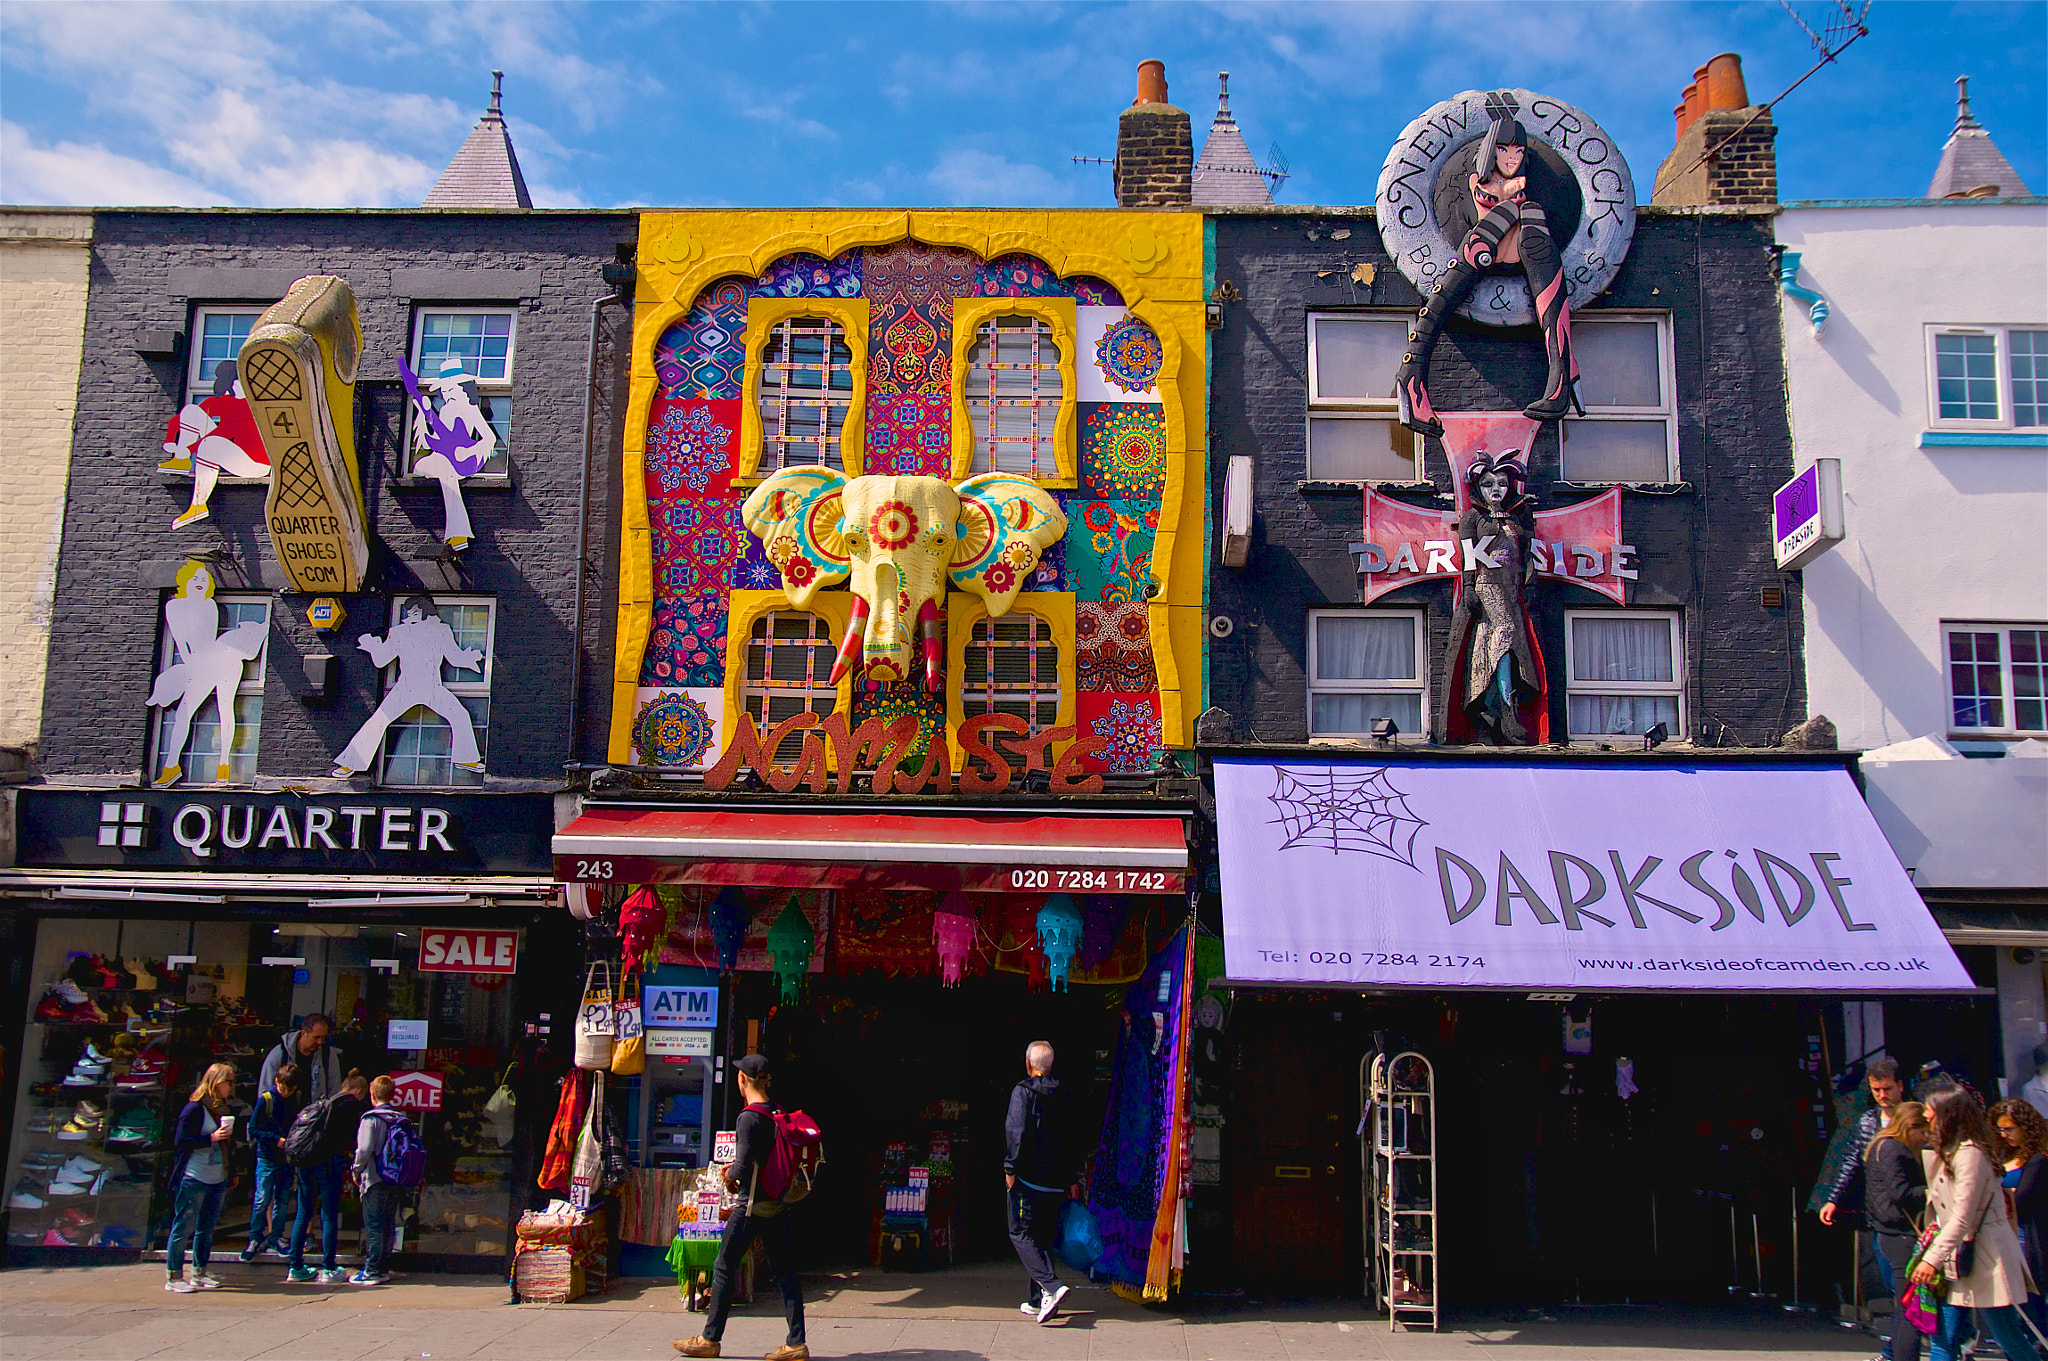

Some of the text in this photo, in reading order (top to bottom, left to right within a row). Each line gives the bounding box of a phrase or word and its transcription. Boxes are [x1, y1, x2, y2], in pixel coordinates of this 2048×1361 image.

[1387, 99, 1626, 238] NEW ROCK
[1489, 284, 1512, 312] &
[273, 411, 294, 434] 4
[271, 516, 341, 535] QUARTER
[286, 542, 337, 560] SHOES
[1348, 534, 1639, 580] DARK SIDE
[313, 607, 331, 618] ADT
[172, 803, 456, 857] QUARTER
[576, 860, 614, 879] 243
[1011, 869, 1165, 890] 020 7284 1742
[424, 934, 513, 966] SALE
[1257, 950, 1486, 968] Tel: 020 7284 2174
[1577, 957, 1930, 972] www.darksideofcamden.co.uk
[585, 989, 611, 999] SALE
[653, 991, 709, 1013] ATM
[389, 1088, 441, 1108] SALE
[716, 1134, 736, 1142] sale
[909, 1170, 929, 1178] sale
[702, 1205, 714, 1221] £1
